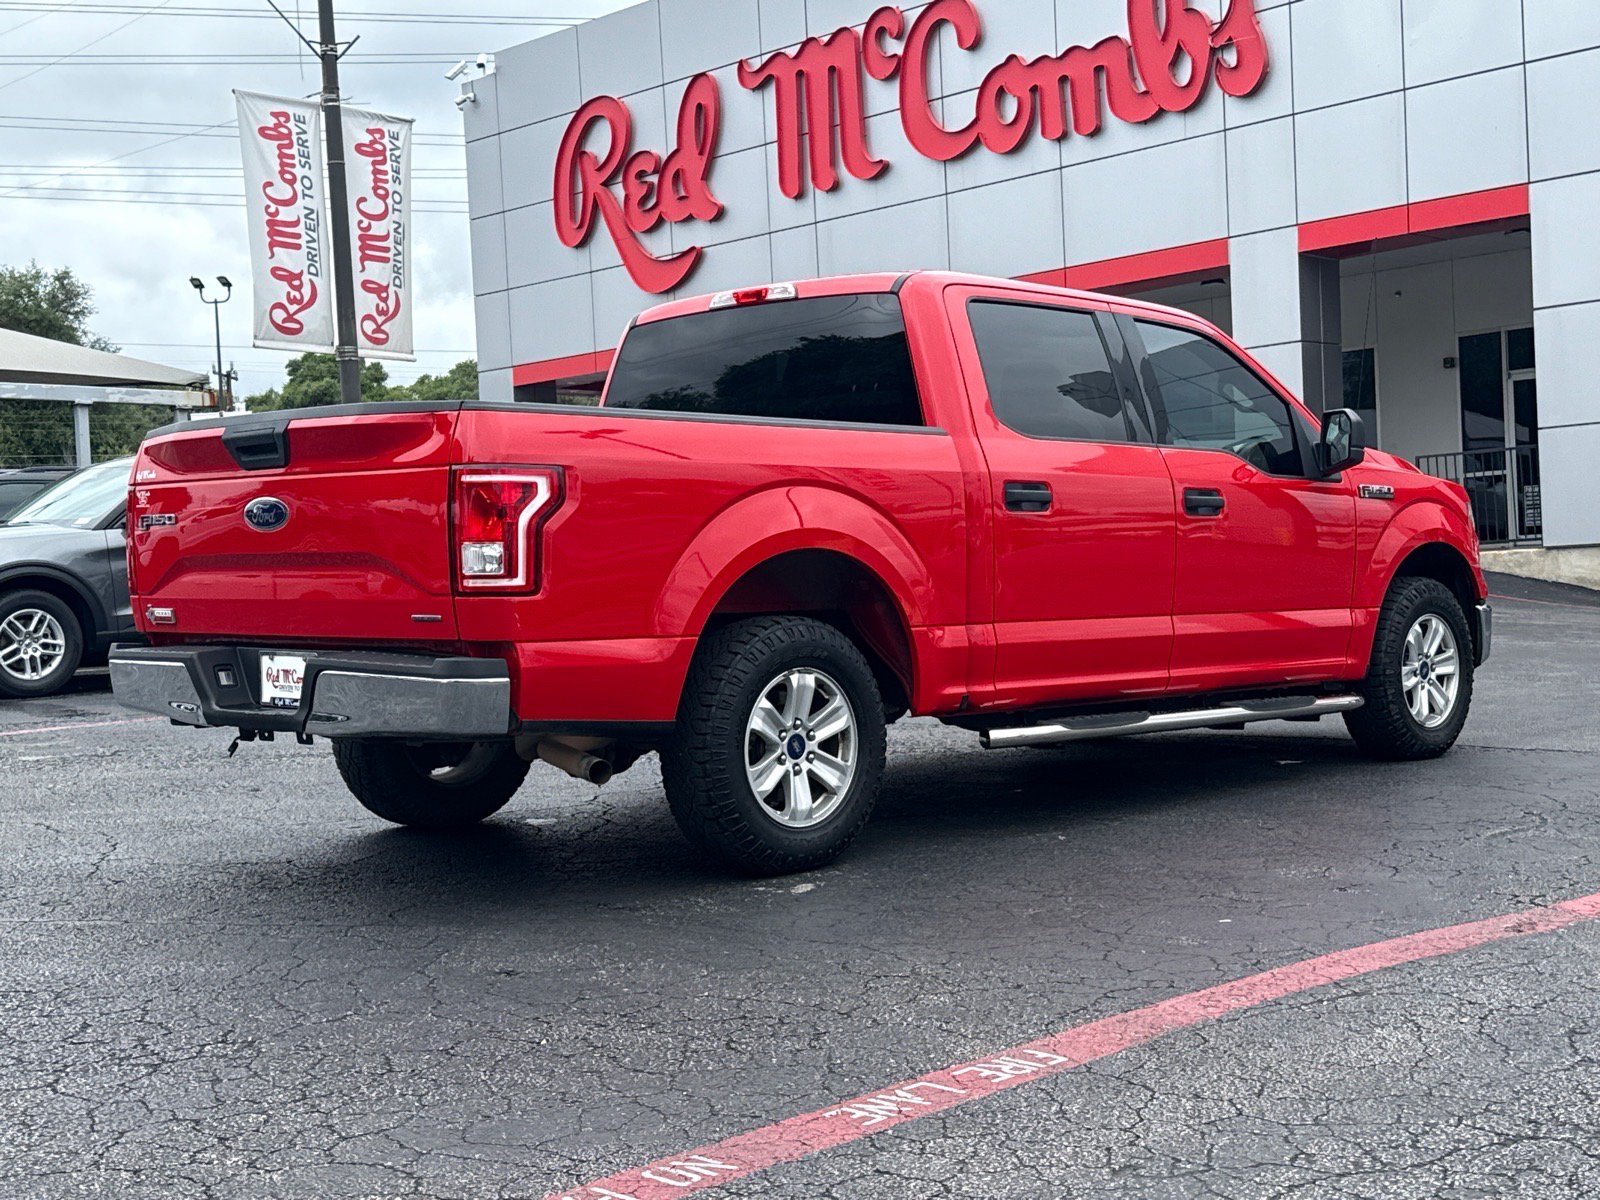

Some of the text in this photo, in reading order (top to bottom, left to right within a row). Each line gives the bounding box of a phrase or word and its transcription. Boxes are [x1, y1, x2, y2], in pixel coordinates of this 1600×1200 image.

[258, 111, 318, 336] Red McCombs
[293, 112, 319, 278] DRIVEN TO SERVE
[388, 129, 403, 290] DRIVEN TO SERVE
[553, 0, 1270, 294] Red McCombs
[354, 127, 401, 346] Red McCombs
[266, 666, 305, 689] Red McCo
[641, 1049, 1069, 1187] FIRE LANE NO
